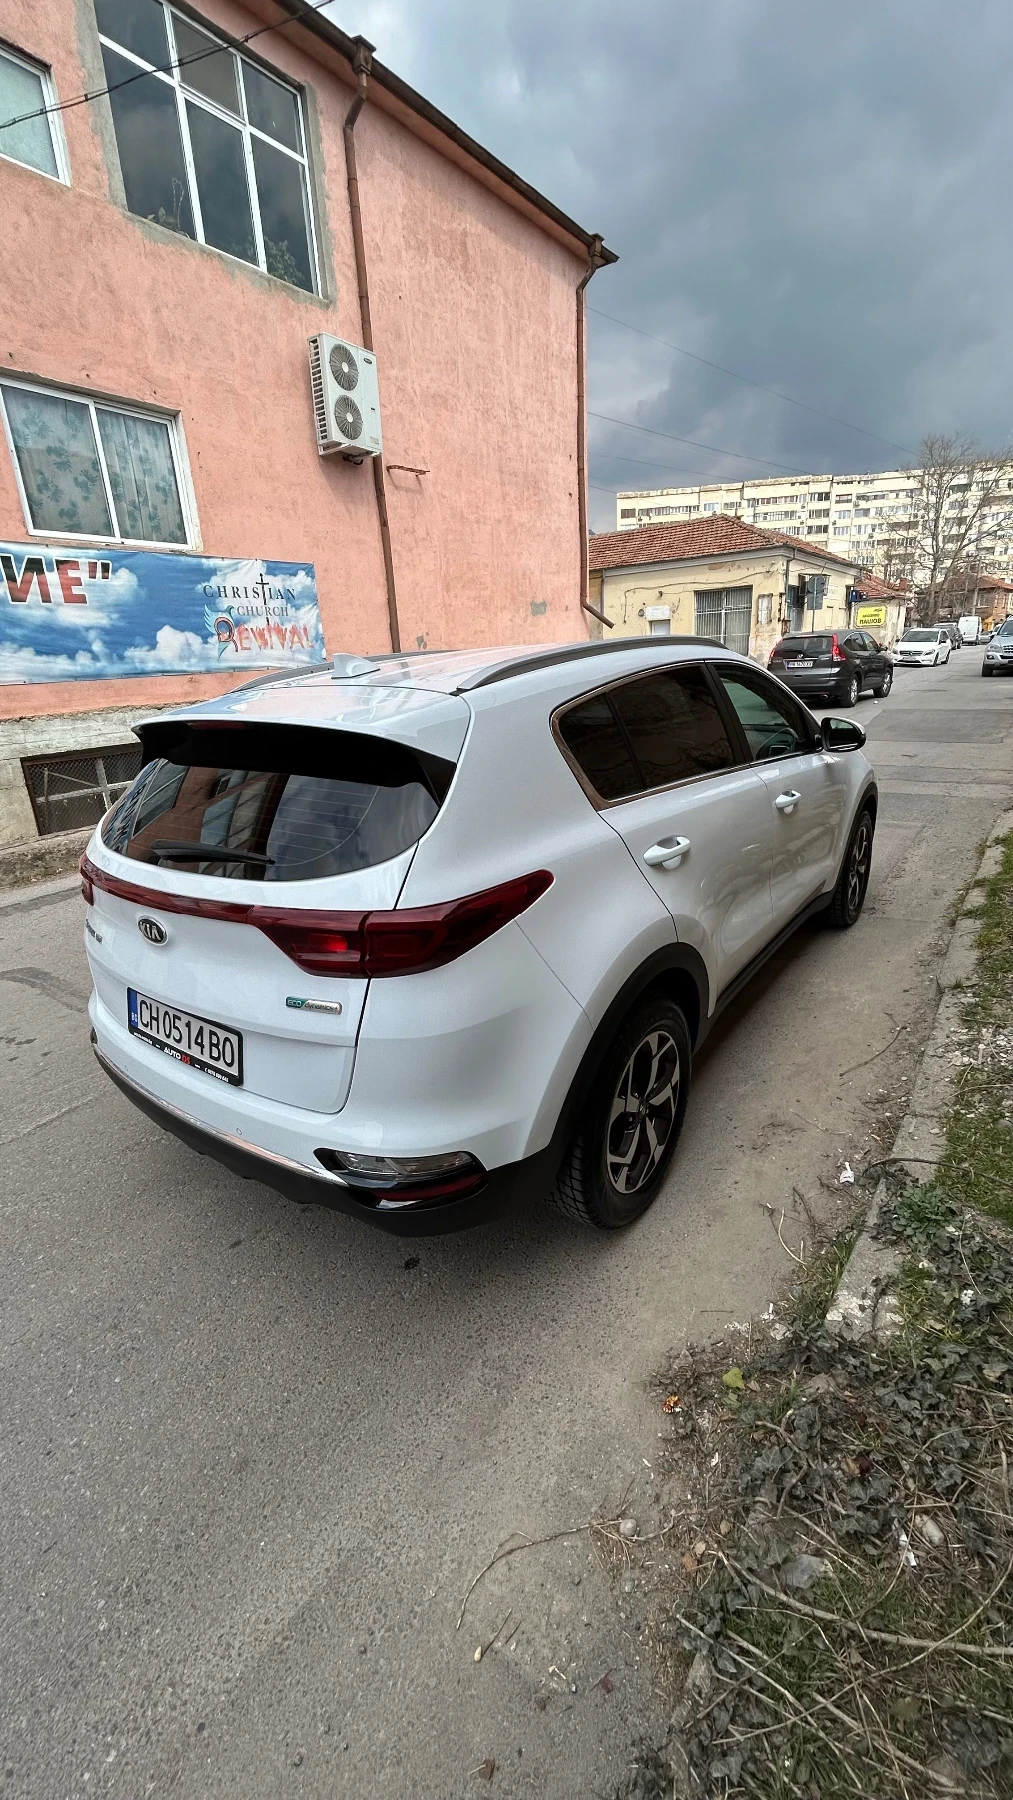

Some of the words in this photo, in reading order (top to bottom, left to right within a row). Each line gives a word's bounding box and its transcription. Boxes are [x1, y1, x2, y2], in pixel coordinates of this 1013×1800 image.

[203, 574, 296, 604] CHRISTIAN
[237, 605, 289, 617] CHURCH
[139, 921, 161, 941] KIA
